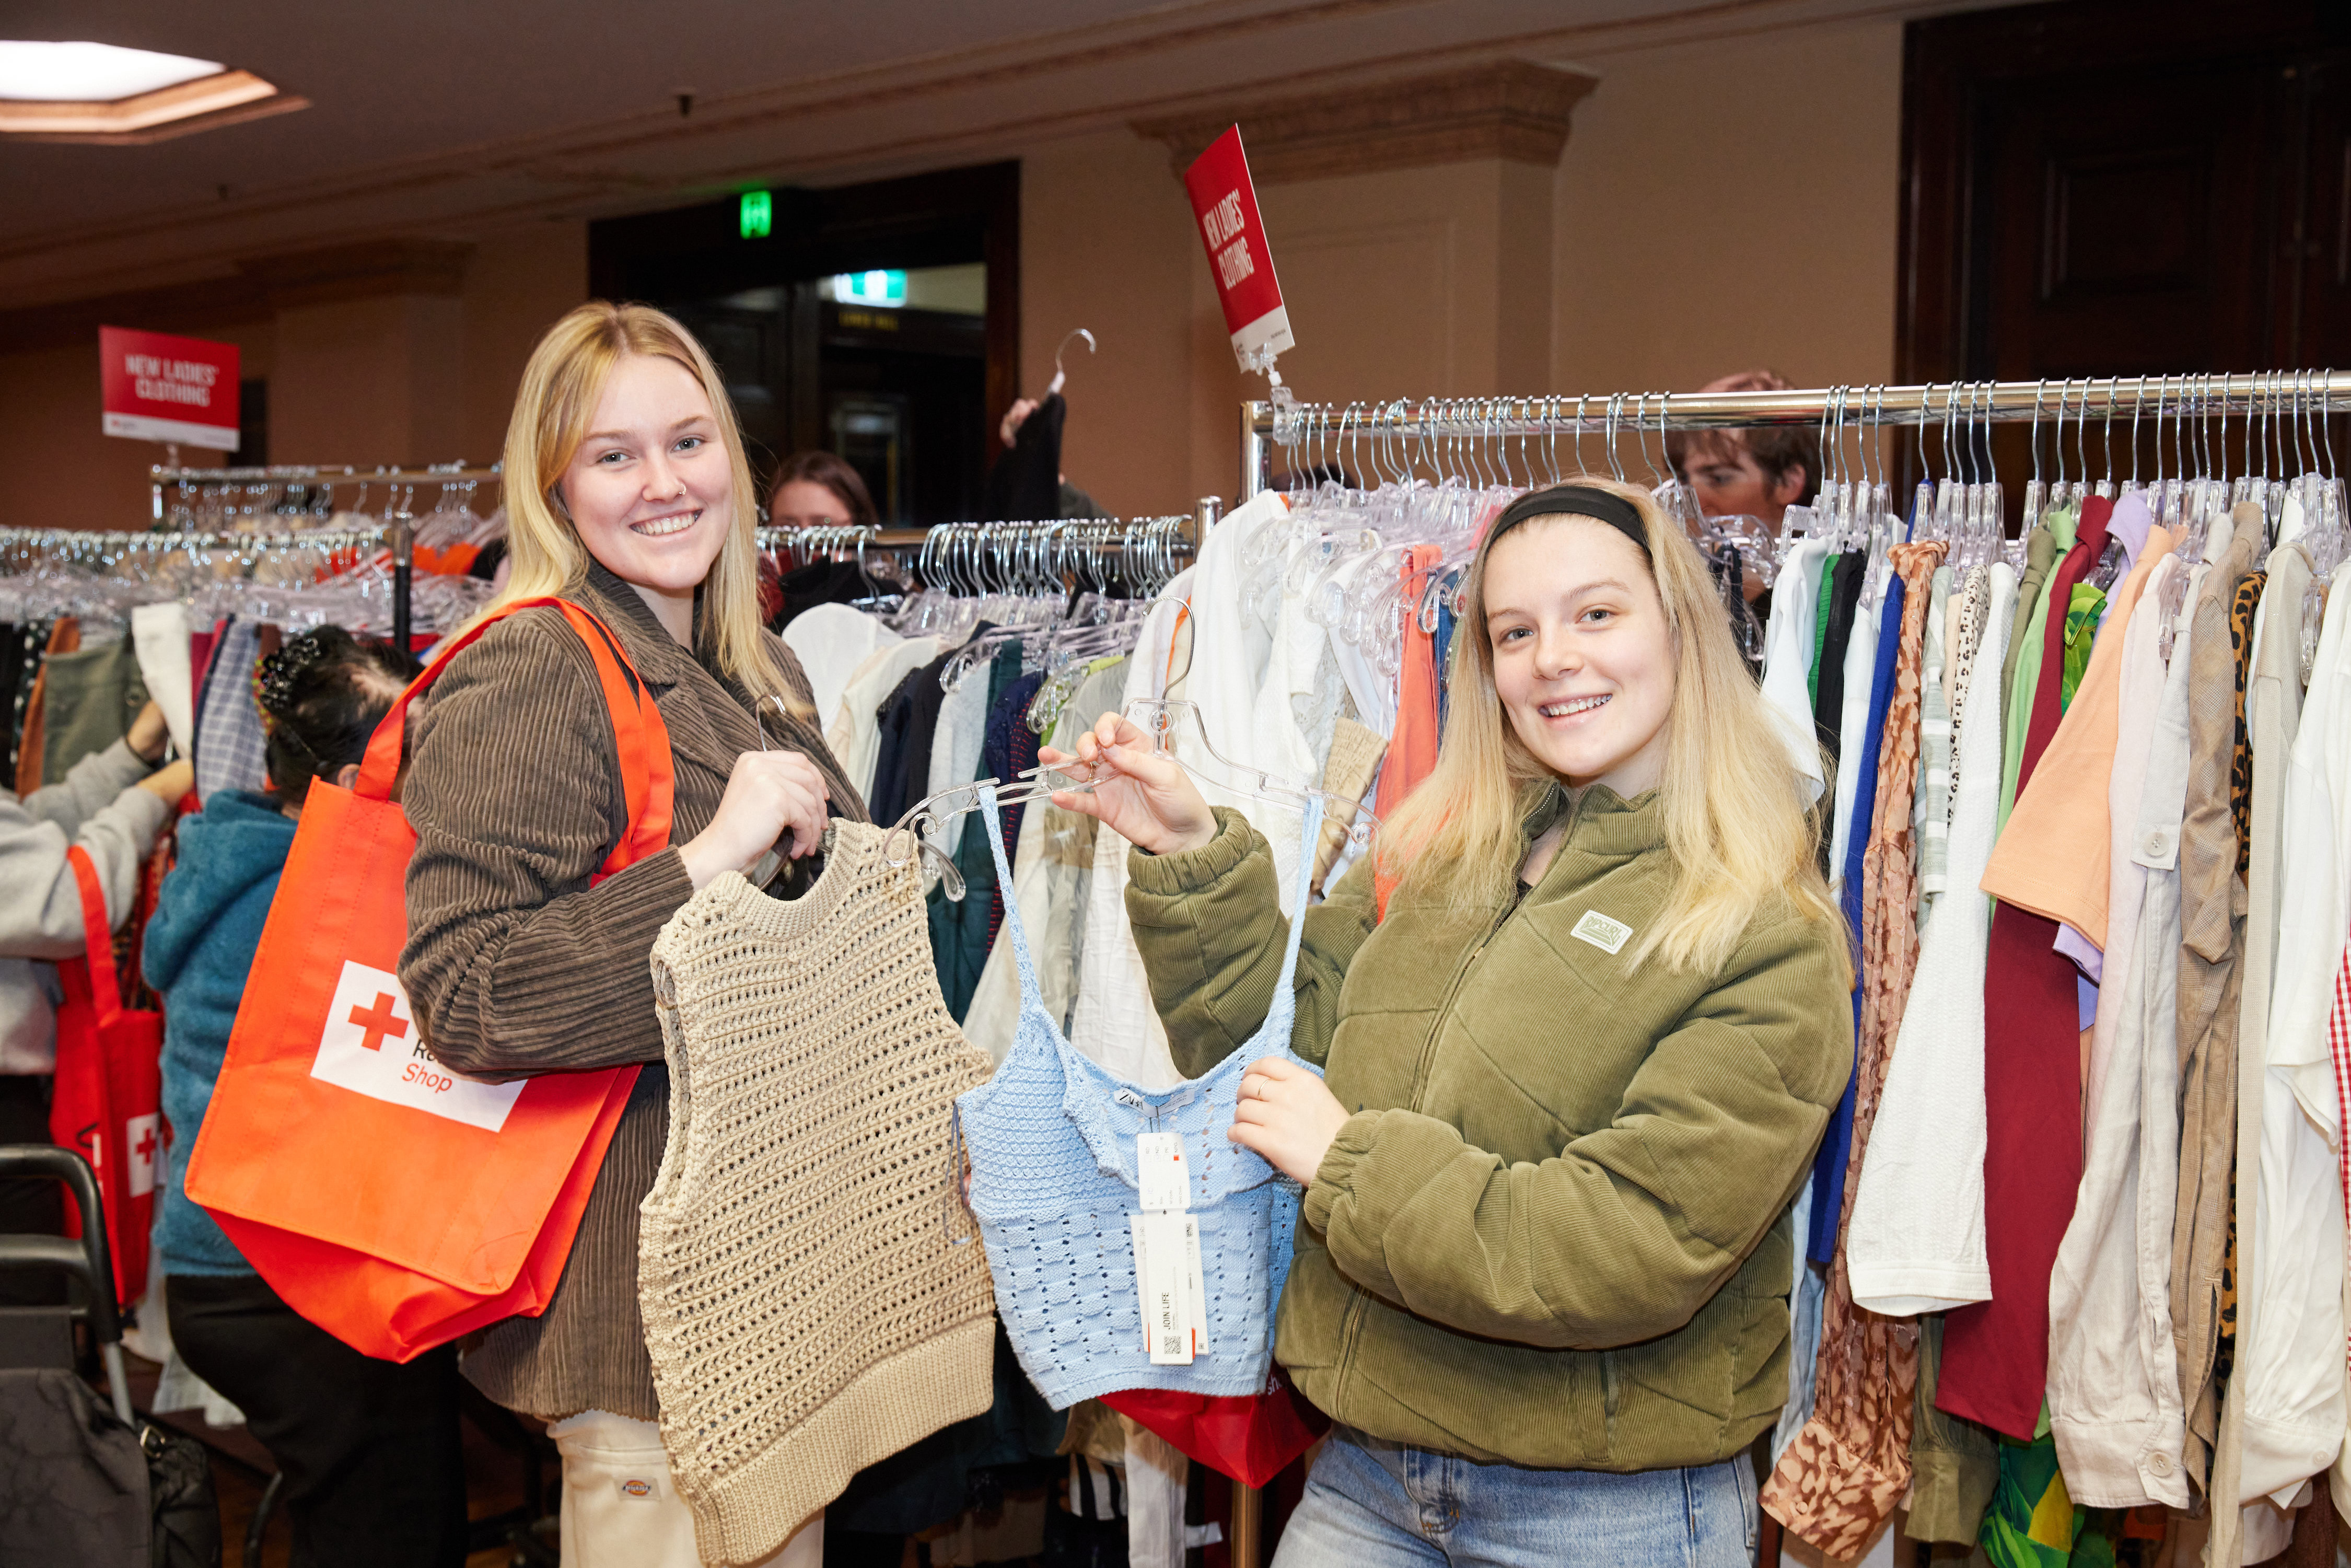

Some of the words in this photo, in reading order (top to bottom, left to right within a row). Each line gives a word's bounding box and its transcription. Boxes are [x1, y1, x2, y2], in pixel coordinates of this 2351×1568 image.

[1218, 236, 1254, 291] CLOTHING
[402, 1063, 452, 1093] Shop
[1120, 1090, 1144, 1110] ZARA
